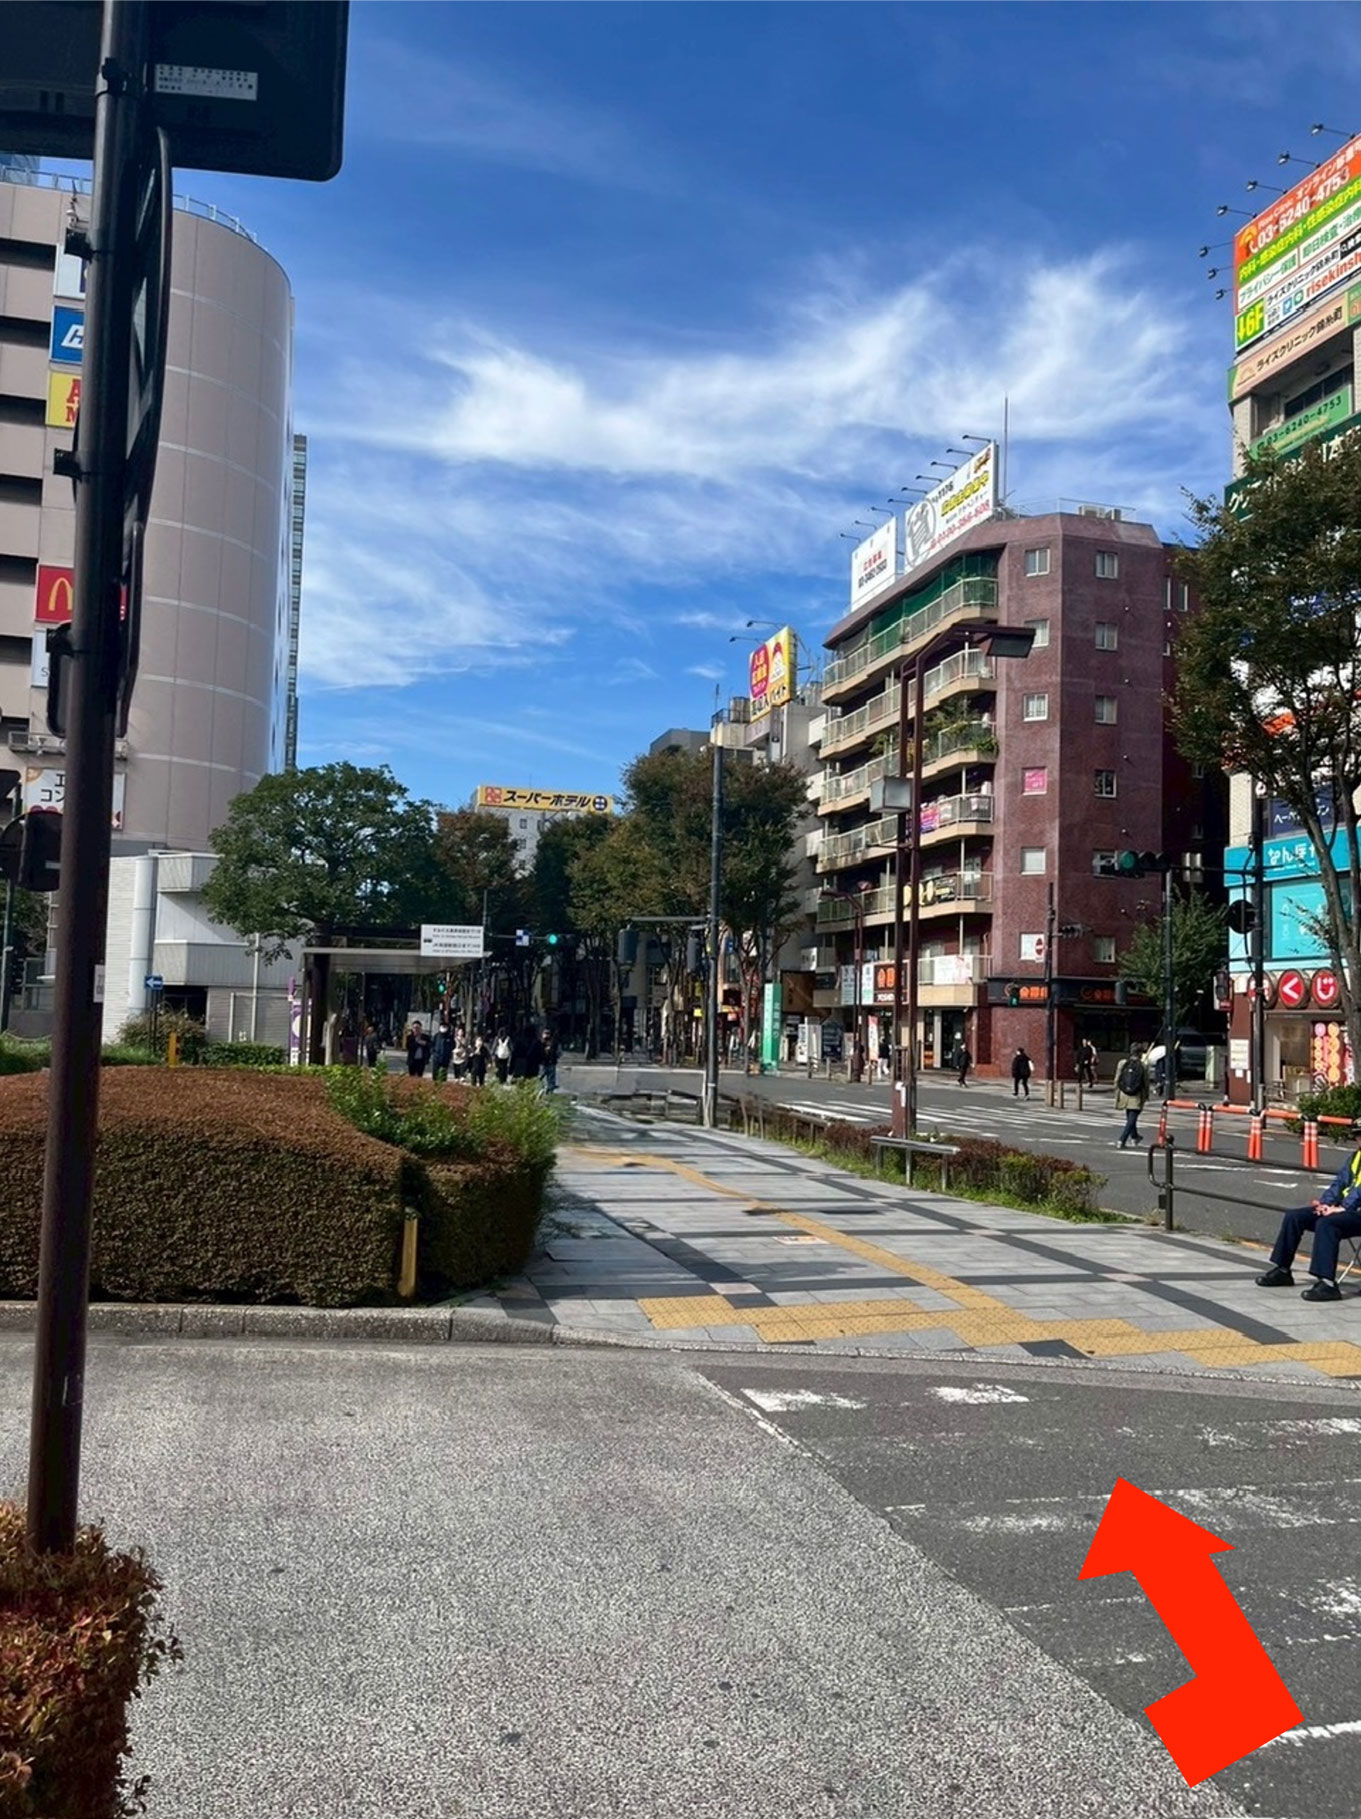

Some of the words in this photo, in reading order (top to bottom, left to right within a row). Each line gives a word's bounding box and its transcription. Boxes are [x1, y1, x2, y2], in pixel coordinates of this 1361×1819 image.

[1246, 303, 1264, 336] 6F
[1257, 306, 1343, 371] ライズクリニック錦糸町
[503, 790, 591, 809] スーパーホテル
